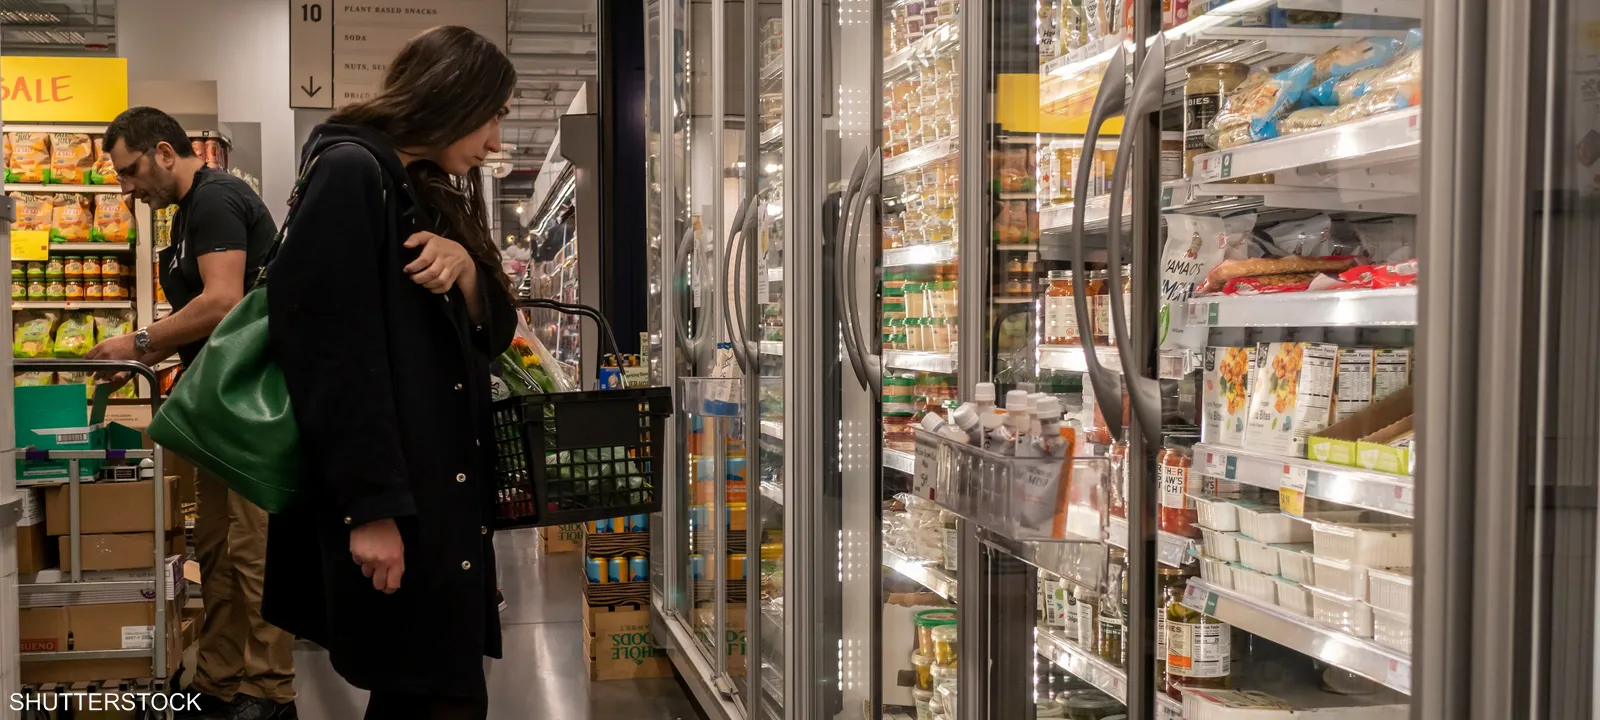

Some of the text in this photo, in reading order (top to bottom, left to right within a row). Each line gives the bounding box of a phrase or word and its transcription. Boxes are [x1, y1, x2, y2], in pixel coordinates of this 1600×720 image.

[301, 4, 322, 22] 10
[344, 63, 370, 71] NUTS,
[1, 75, 73, 104] SALE
[1188, 97, 1213, 105] BIES.
[1165, 259, 1190, 275] AMA
[1165, 467, 1183, 476] THER
[1165, 476, 1183, 485] AW'S
[620, 624, 650, 632] ARKET
[611, 633, 651, 646] OODS
